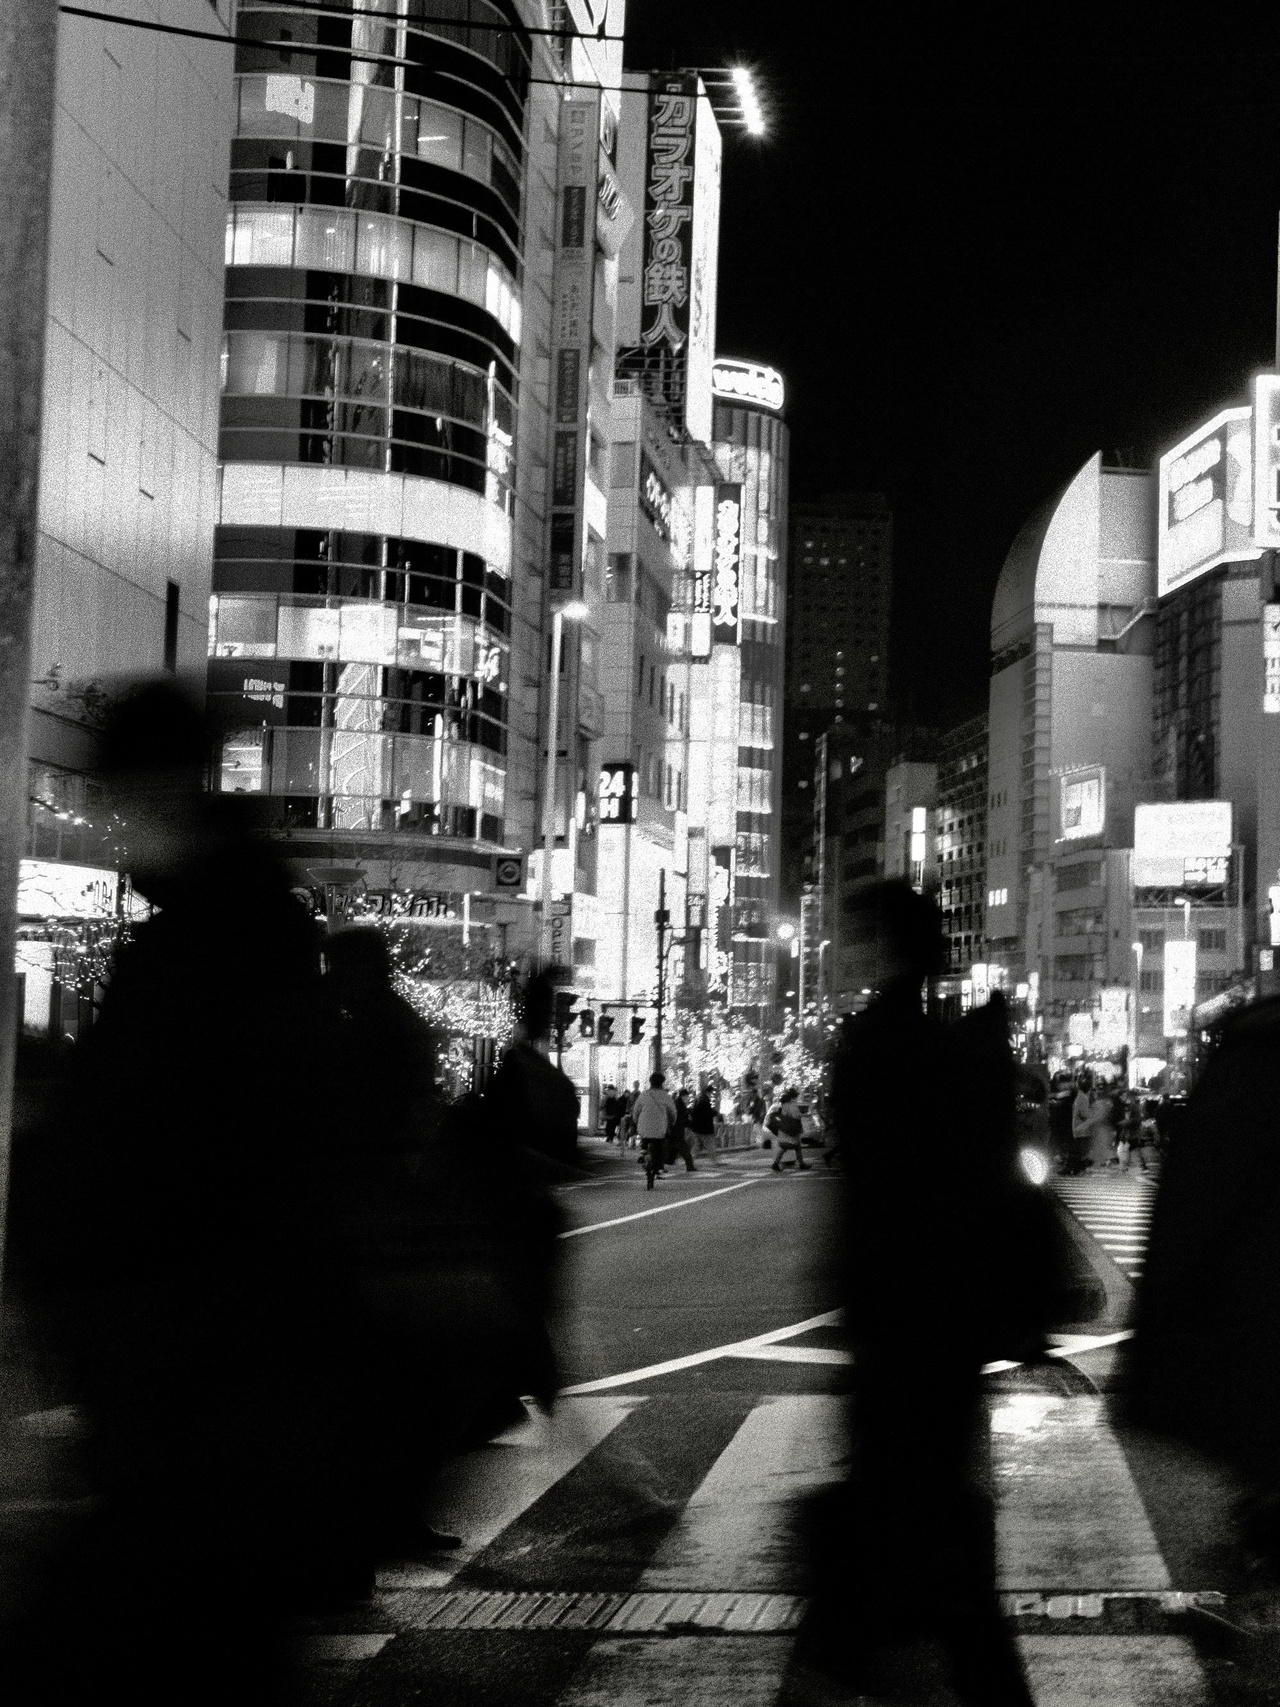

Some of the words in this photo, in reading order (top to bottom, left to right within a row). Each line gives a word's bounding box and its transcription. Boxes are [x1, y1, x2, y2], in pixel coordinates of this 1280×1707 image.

[642, 84, 694, 353] カラオケの鉄人
[599, 771, 625, 797] 24
[600, 798, 619, 819] H
